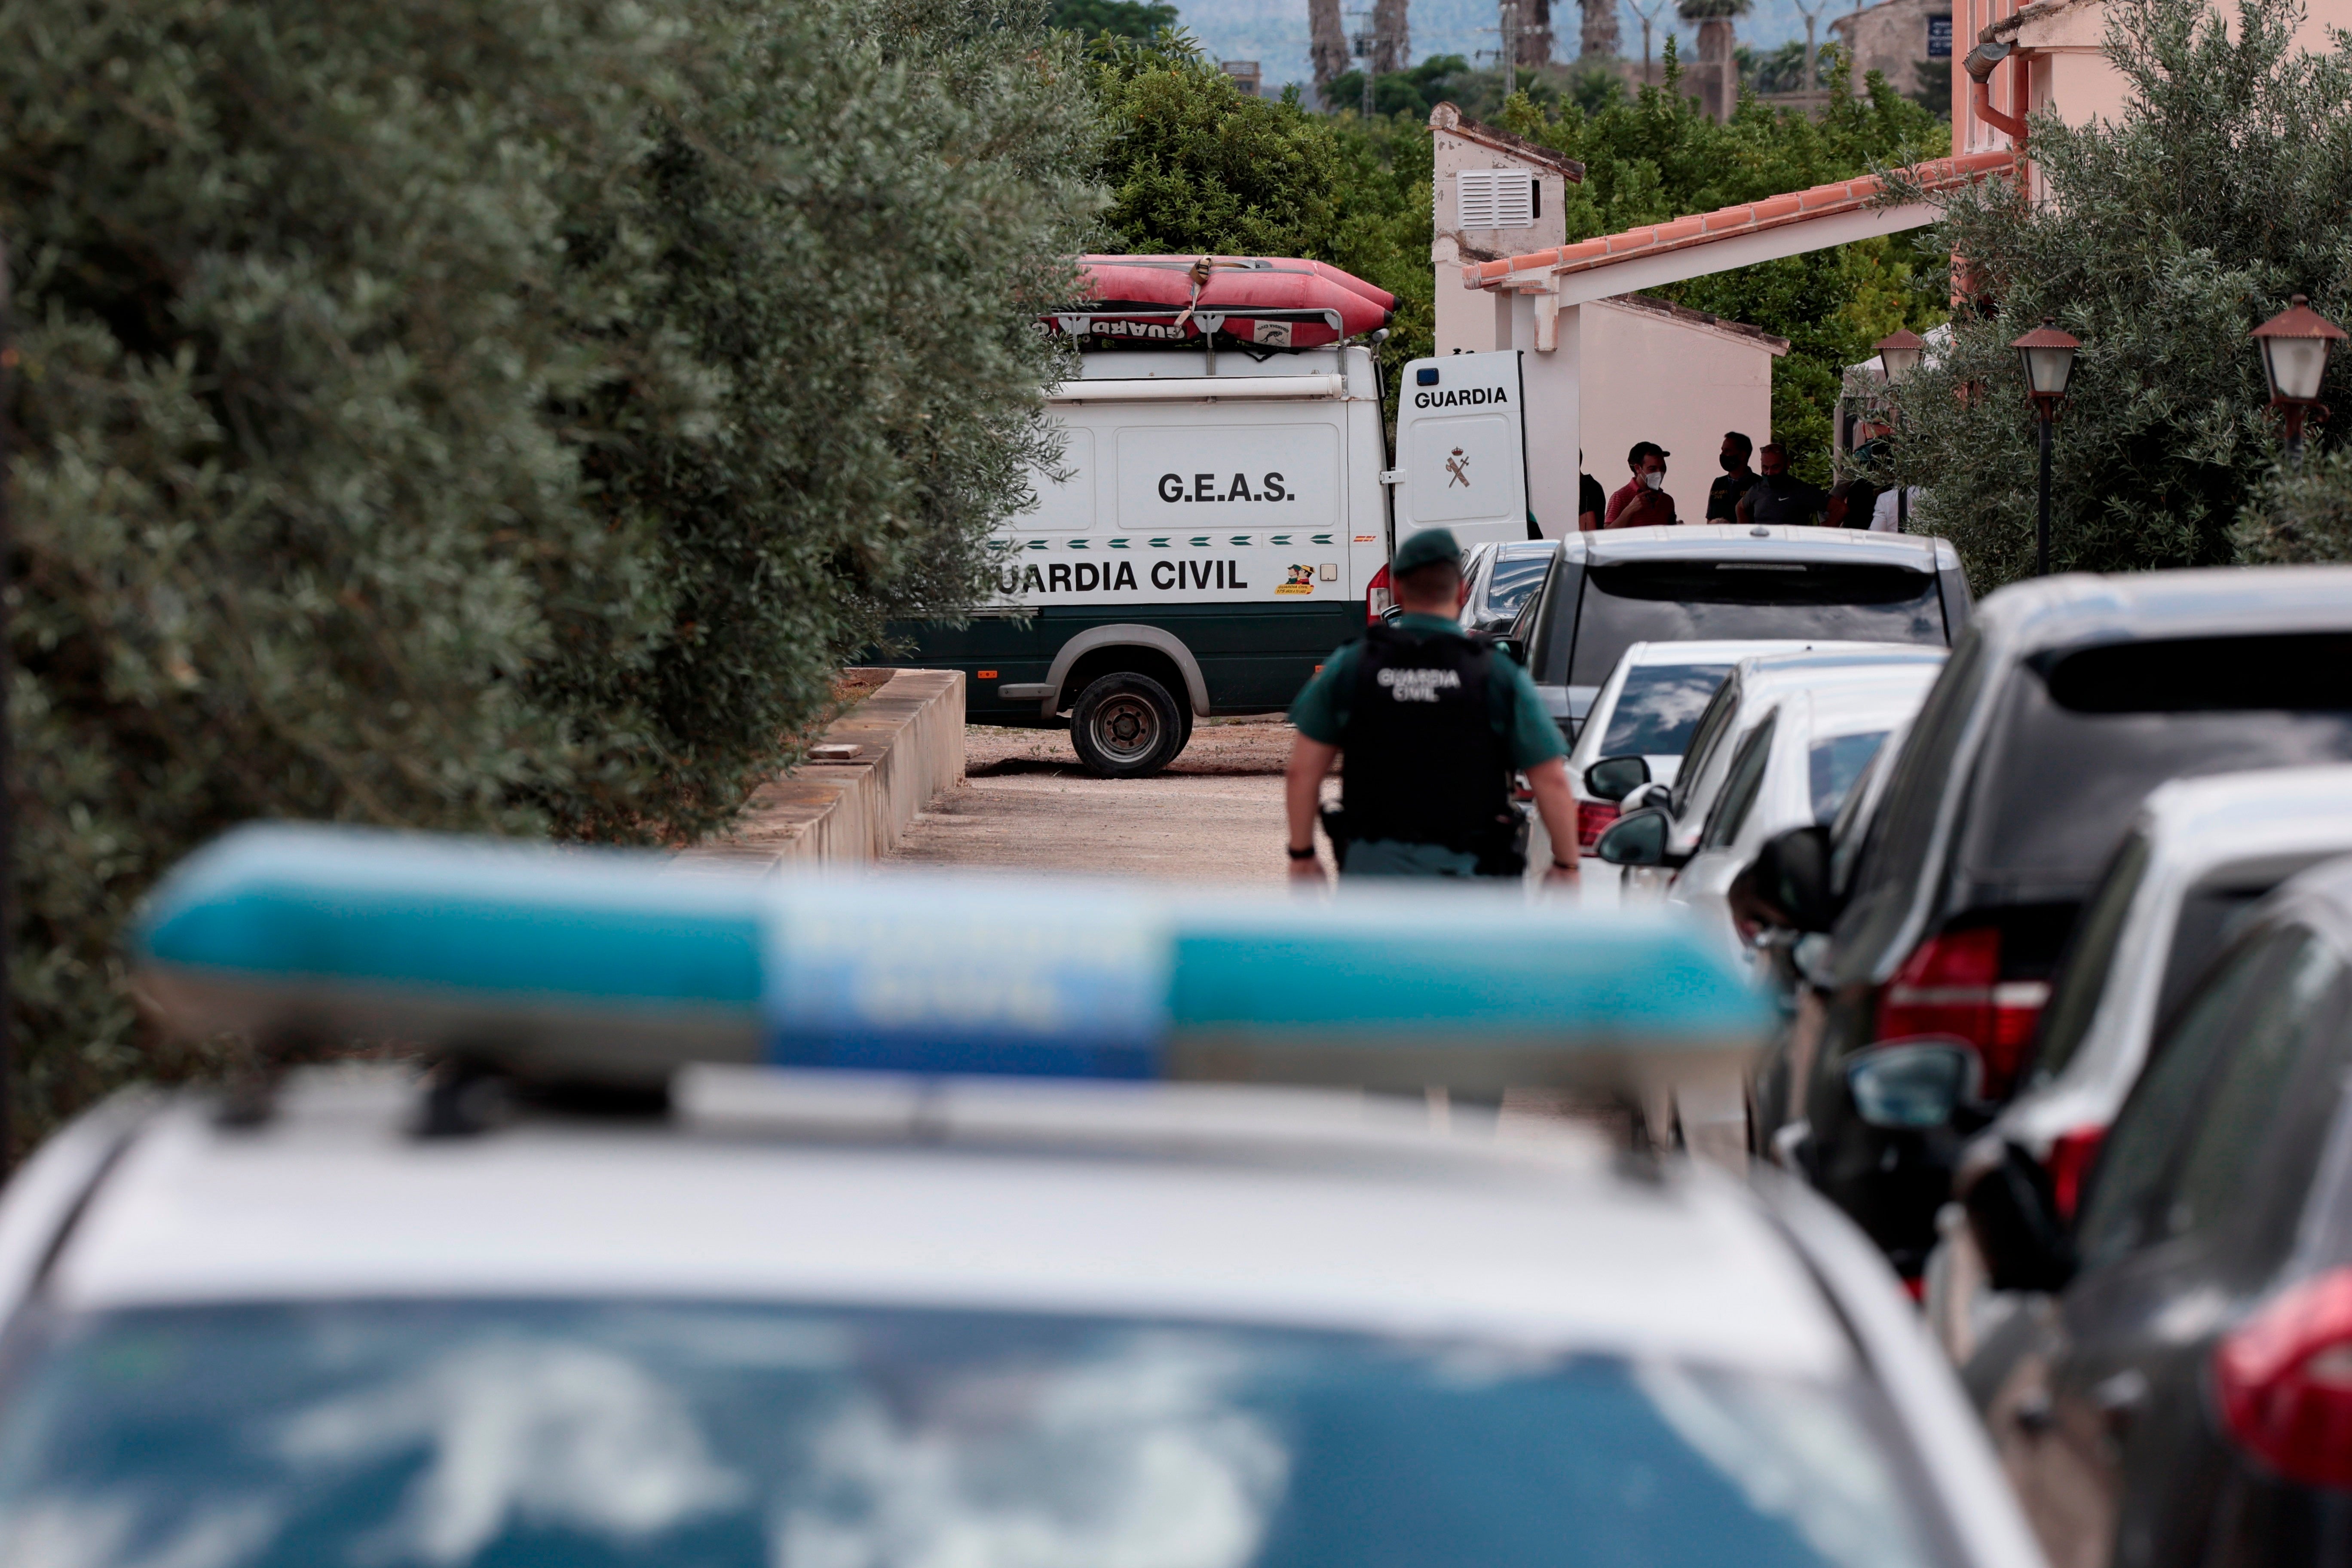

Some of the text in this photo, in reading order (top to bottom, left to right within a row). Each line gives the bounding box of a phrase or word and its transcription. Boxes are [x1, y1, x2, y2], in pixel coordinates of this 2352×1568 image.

[1269, 324, 1289, 333] GUARDIA
[1415, 387, 1508, 408] GUARDIA
[1158, 472, 1295, 503] G.E.A.S.
[995, 560, 1248, 594] UARDIA CIVIL
[1377, 668, 1461, 688] GUARDIA
[1392, 687, 1440, 702] CIVIL
